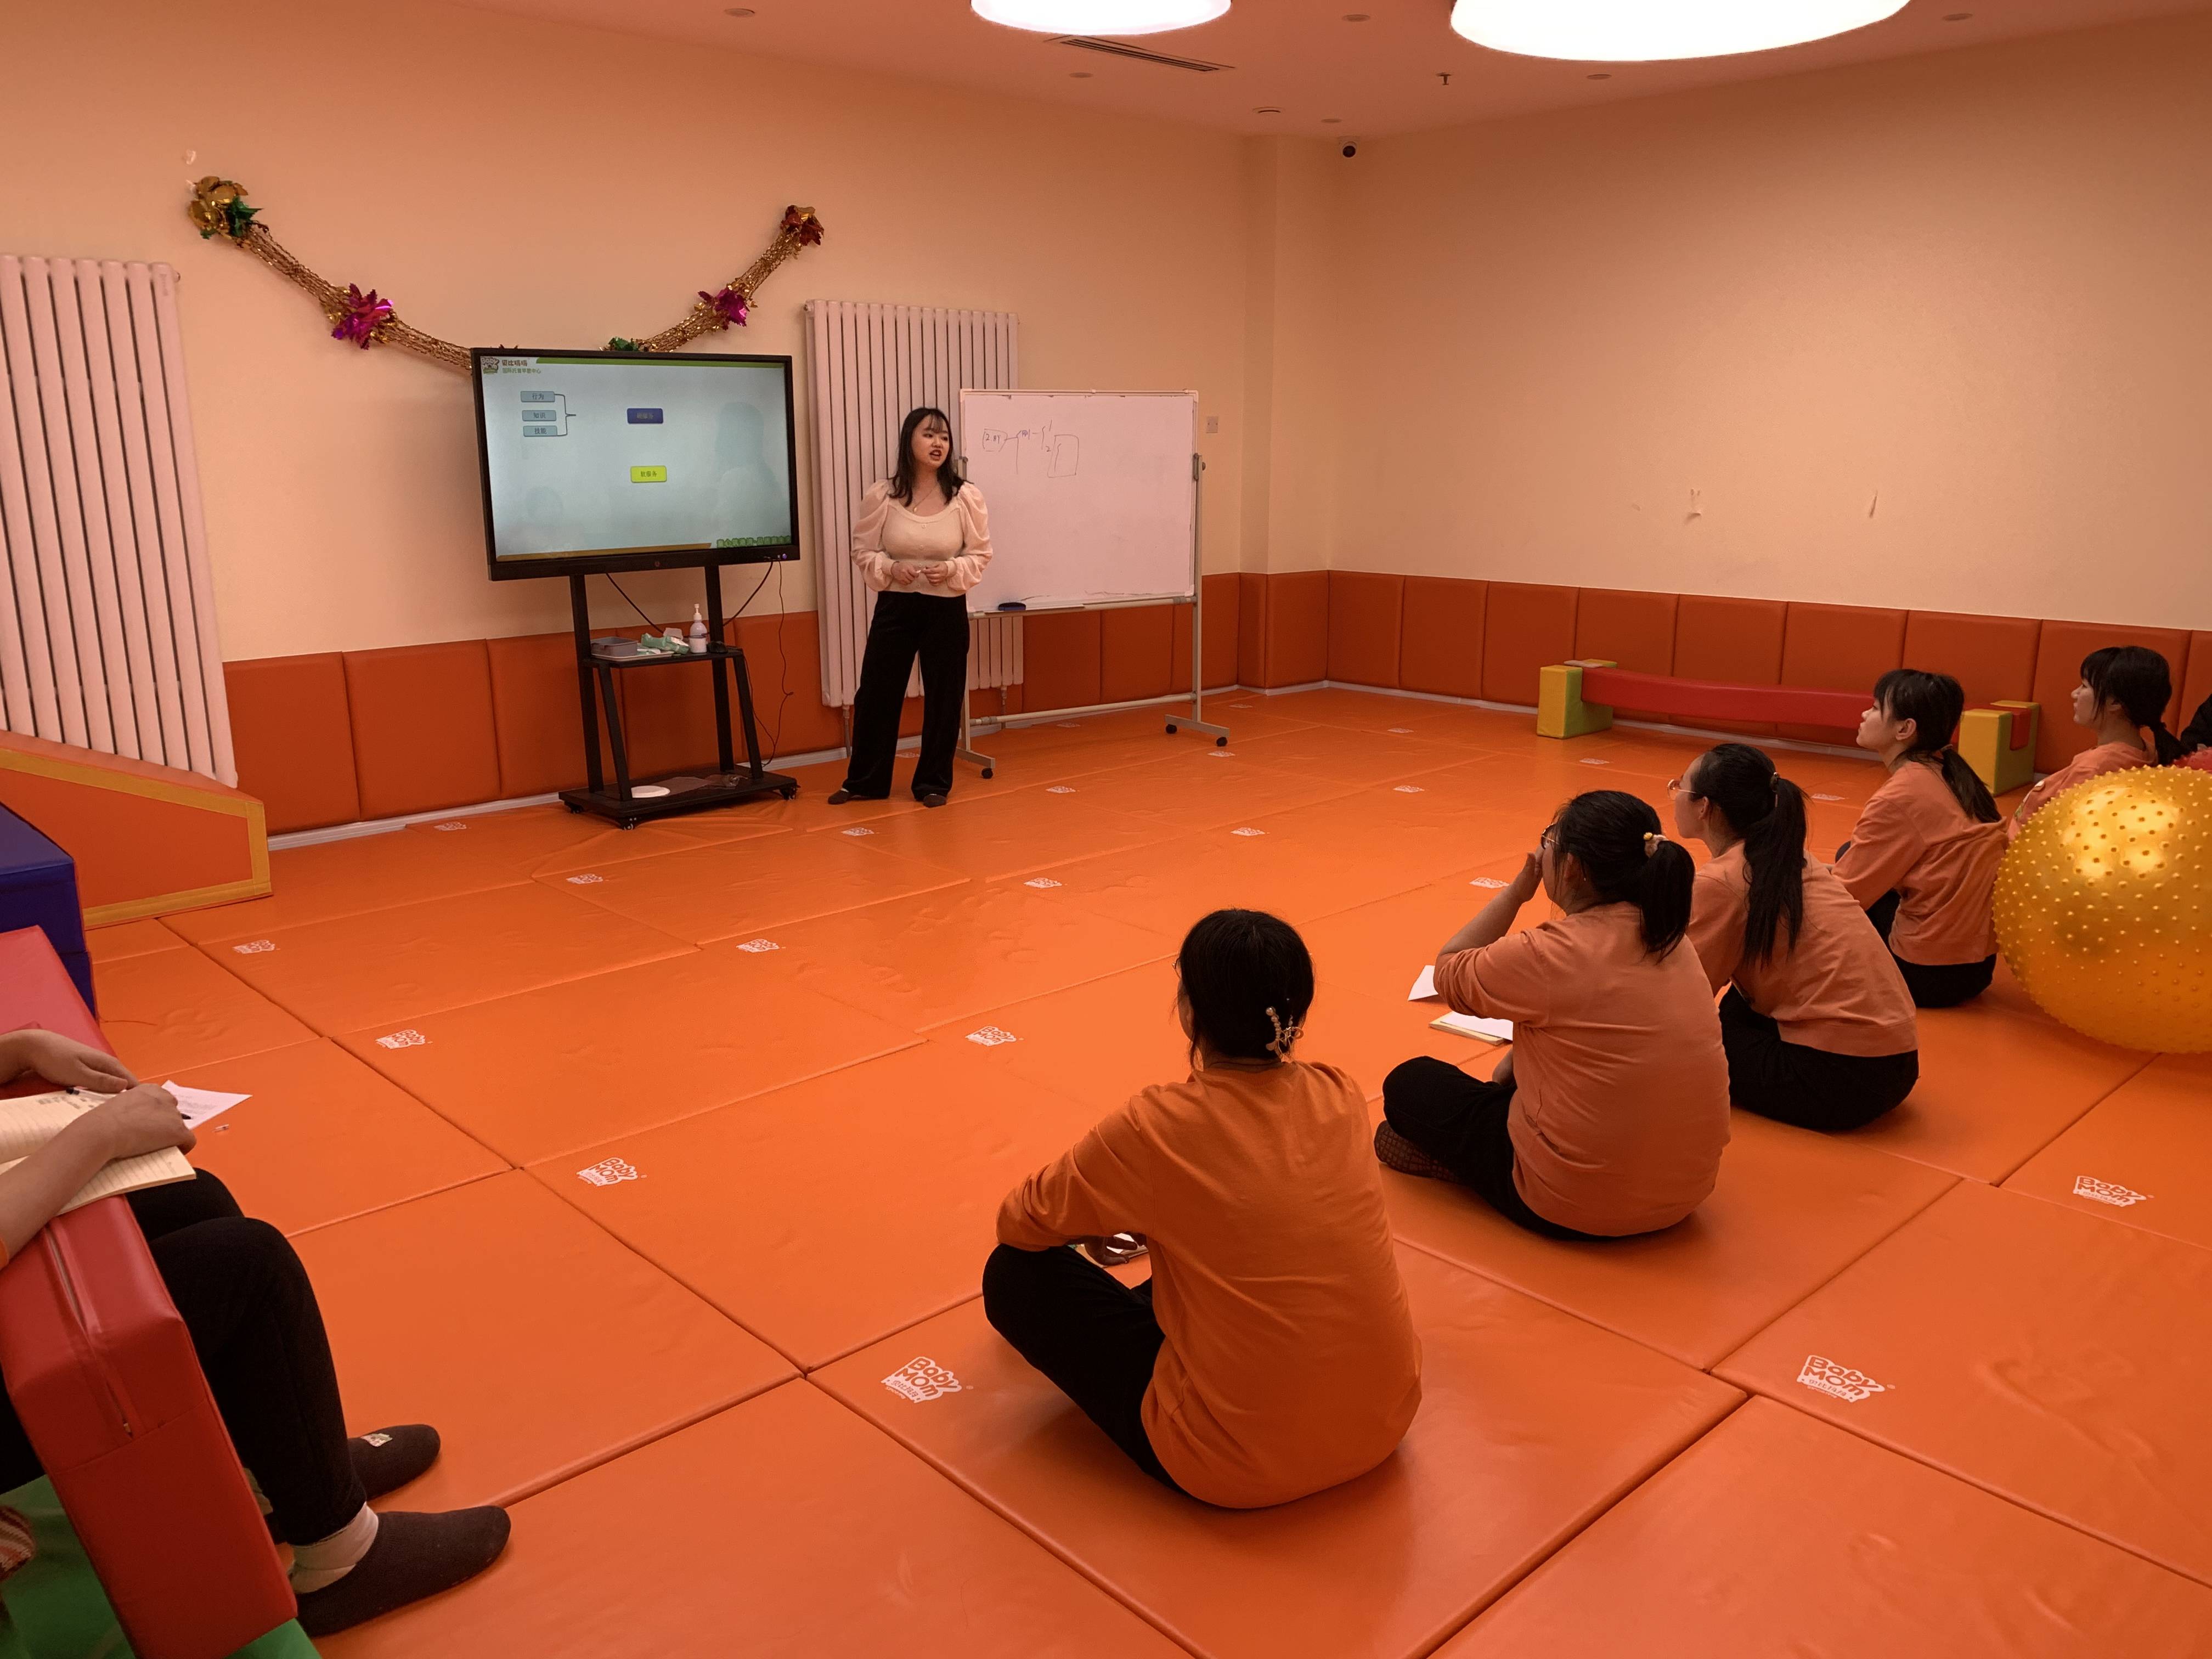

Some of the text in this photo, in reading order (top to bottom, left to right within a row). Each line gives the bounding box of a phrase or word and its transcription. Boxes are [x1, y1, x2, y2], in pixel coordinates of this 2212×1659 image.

[2079, 1177, 2141, 1198] Baby
[908, 1358, 958, 1389] Baby
[1808, 1356, 1880, 1389] Baby
